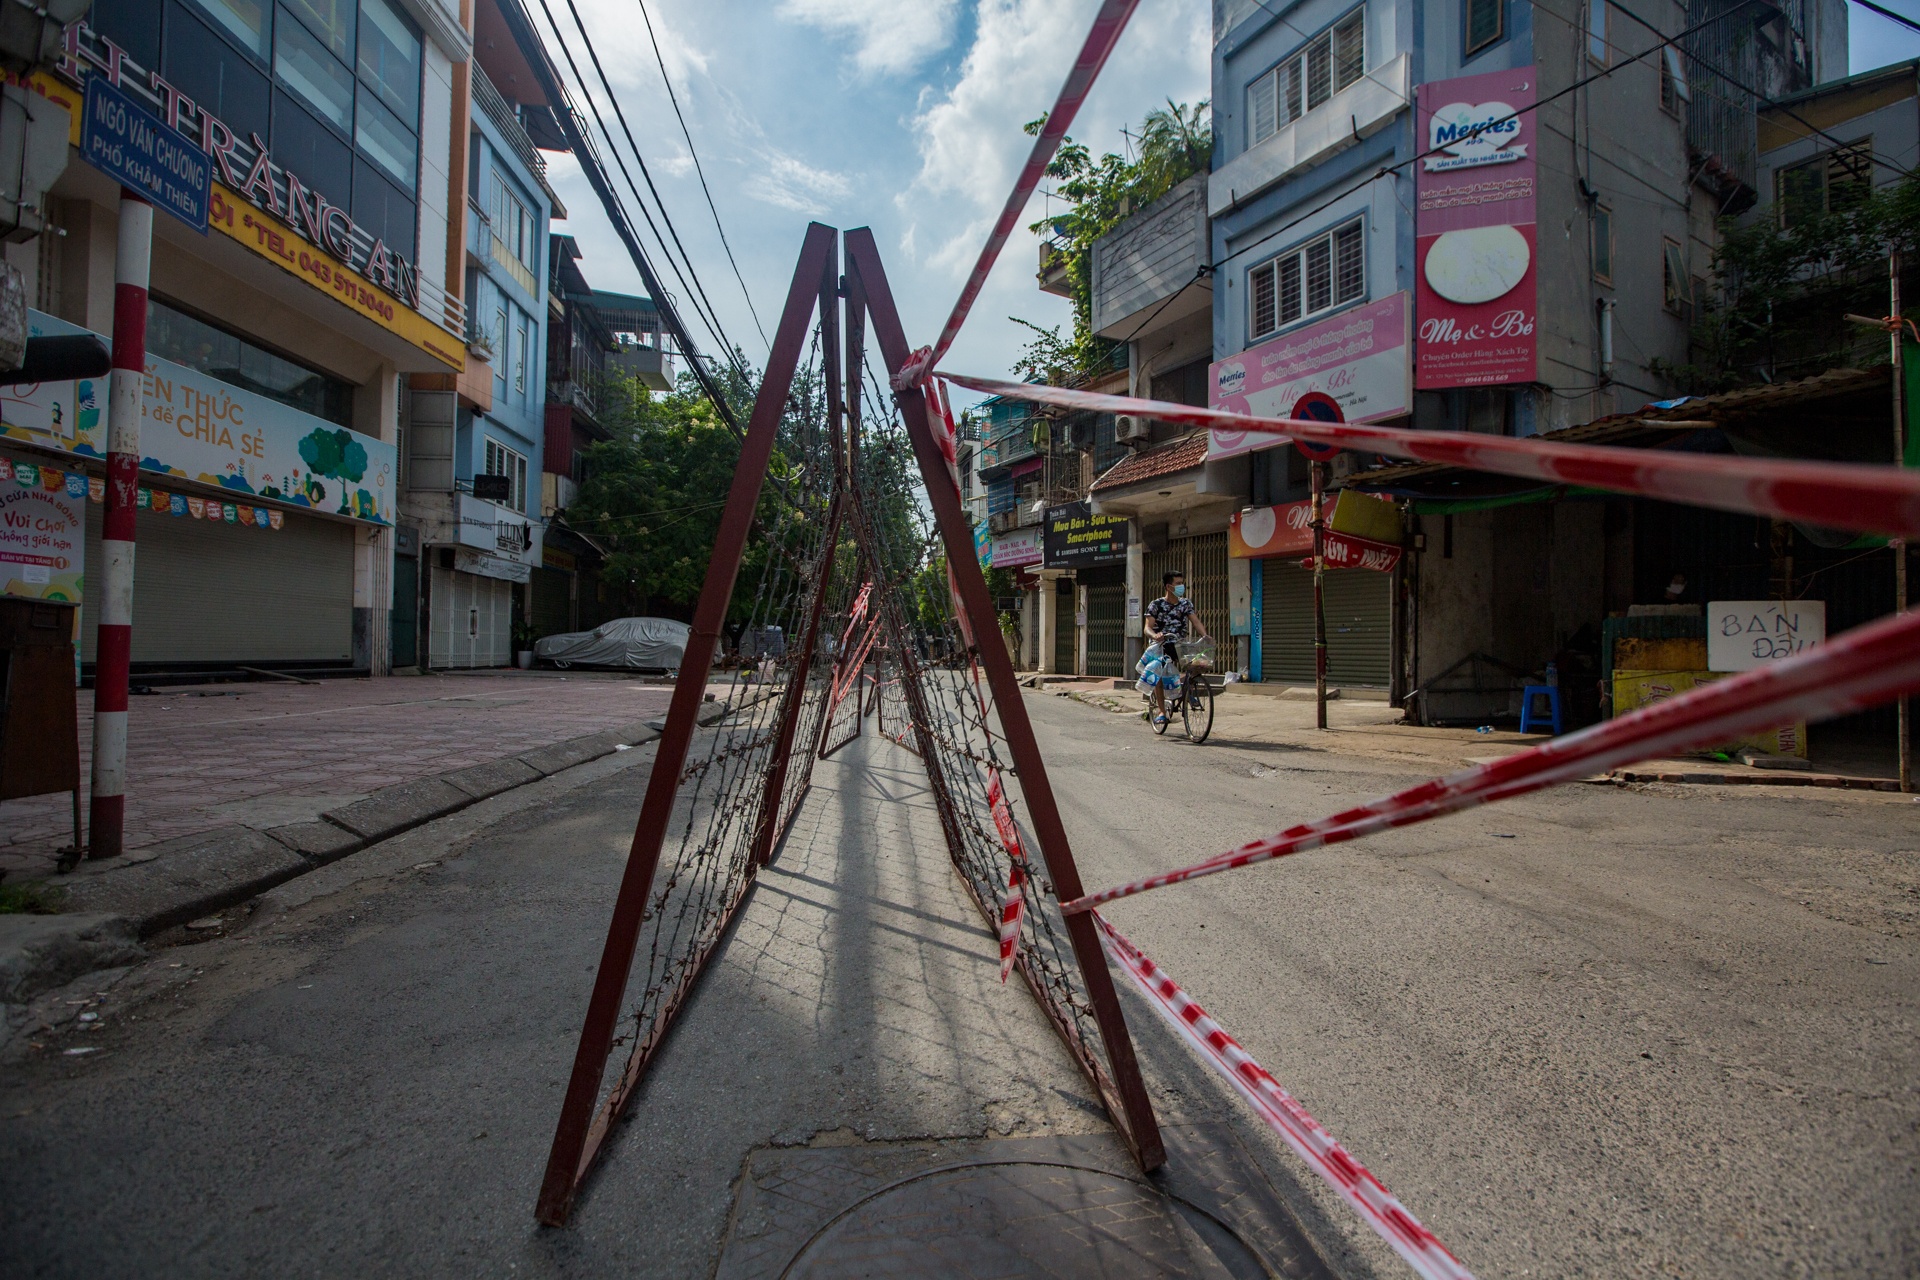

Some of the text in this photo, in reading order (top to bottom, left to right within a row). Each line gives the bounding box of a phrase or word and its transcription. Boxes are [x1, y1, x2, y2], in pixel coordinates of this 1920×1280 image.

[96, 92, 126, 136] NGÕ
[129, 115, 155, 157] VĂN
[156, 136, 205, 191] CHƯƠNG
[1436, 116, 1517, 144] Merries
[93, 134, 199, 217] PHỐ KHÂM THIÊN
[209, 190, 234, 226] ỘI
[299, 251, 331, 283] 043
[334, 275, 394, 321] 5113040
[363, 238, 422, 310] AN
[1420, 310, 1534, 344] Mẹ & Bé
[1451, 351, 1473, 359] Order
[1516, 346, 1530, 355] Tay
[143, 364, 172, 403] ẾN
[1219, 371, 1246, 386] Merries
[176, 414, 234, 449] CHIA
[240, 428, 264, 459] SẺ
[4, 511, 66, 533] Vui Chơi
[6, 490, 30, 503] CỬA
[55, 502, 79, 528] BÓNG
[1053, 522, 1069, 532] Mua
[1070, 517, 1085, 529] Bán
[1067, 528, 1113, 544] Smartphone
[32, 534, 51, 548] giới
[53, 539, 72, 551] hạn
[1323, 537, 1348, 563] BÚN
[57, 558, 65, 569] 1
[1721, 606, 1799, 637] BÁN
